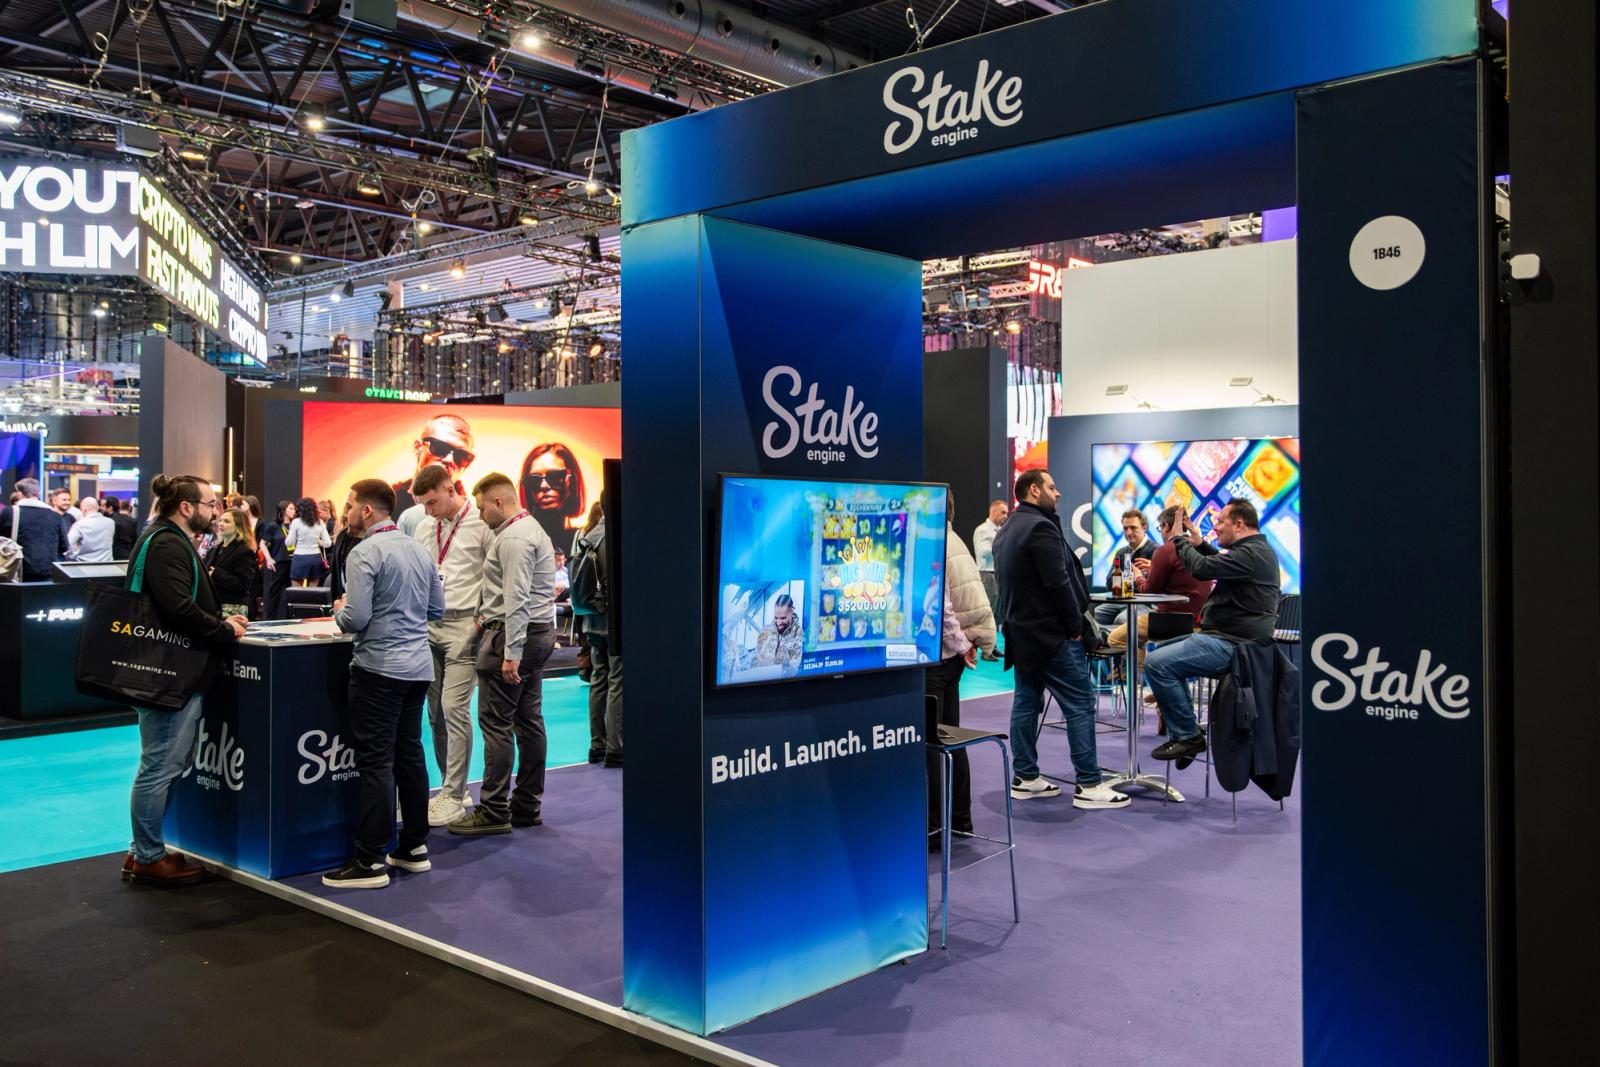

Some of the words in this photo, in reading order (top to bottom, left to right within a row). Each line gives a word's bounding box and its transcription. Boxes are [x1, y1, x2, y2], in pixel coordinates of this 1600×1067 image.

[883, 59, 1023, 155] Stake
[931, 127, 979, 146] engine
[139, 176, 187, 256] CRYPTO
[50, 223, 139, 270] LIM
[1372, 245, 1401, 260] 1B46
[147, 236, 178, 297] FAST
[178, 263, 220, 329] PAYOUTS
[762, 365, 879, 459] Stake
[807, 446, 846, 464] engine
[111, 659, 177, 677] www.sagaming.com
[233, 659, 261, 681] Earn.
[1311, 632, 1471, 719] Stake
[1365, 704, 1419, 720] engine
[192, 718, 245, 791] take
[297, 729, 357, 785] Sta
[332, 769, 361, 781] engine
[711, 746, 778, 784] Build.
[784, 730, 867, 767] Launch.
[872, 724, 921, 750] Earn.
[197, 774, 220, 790] engine
